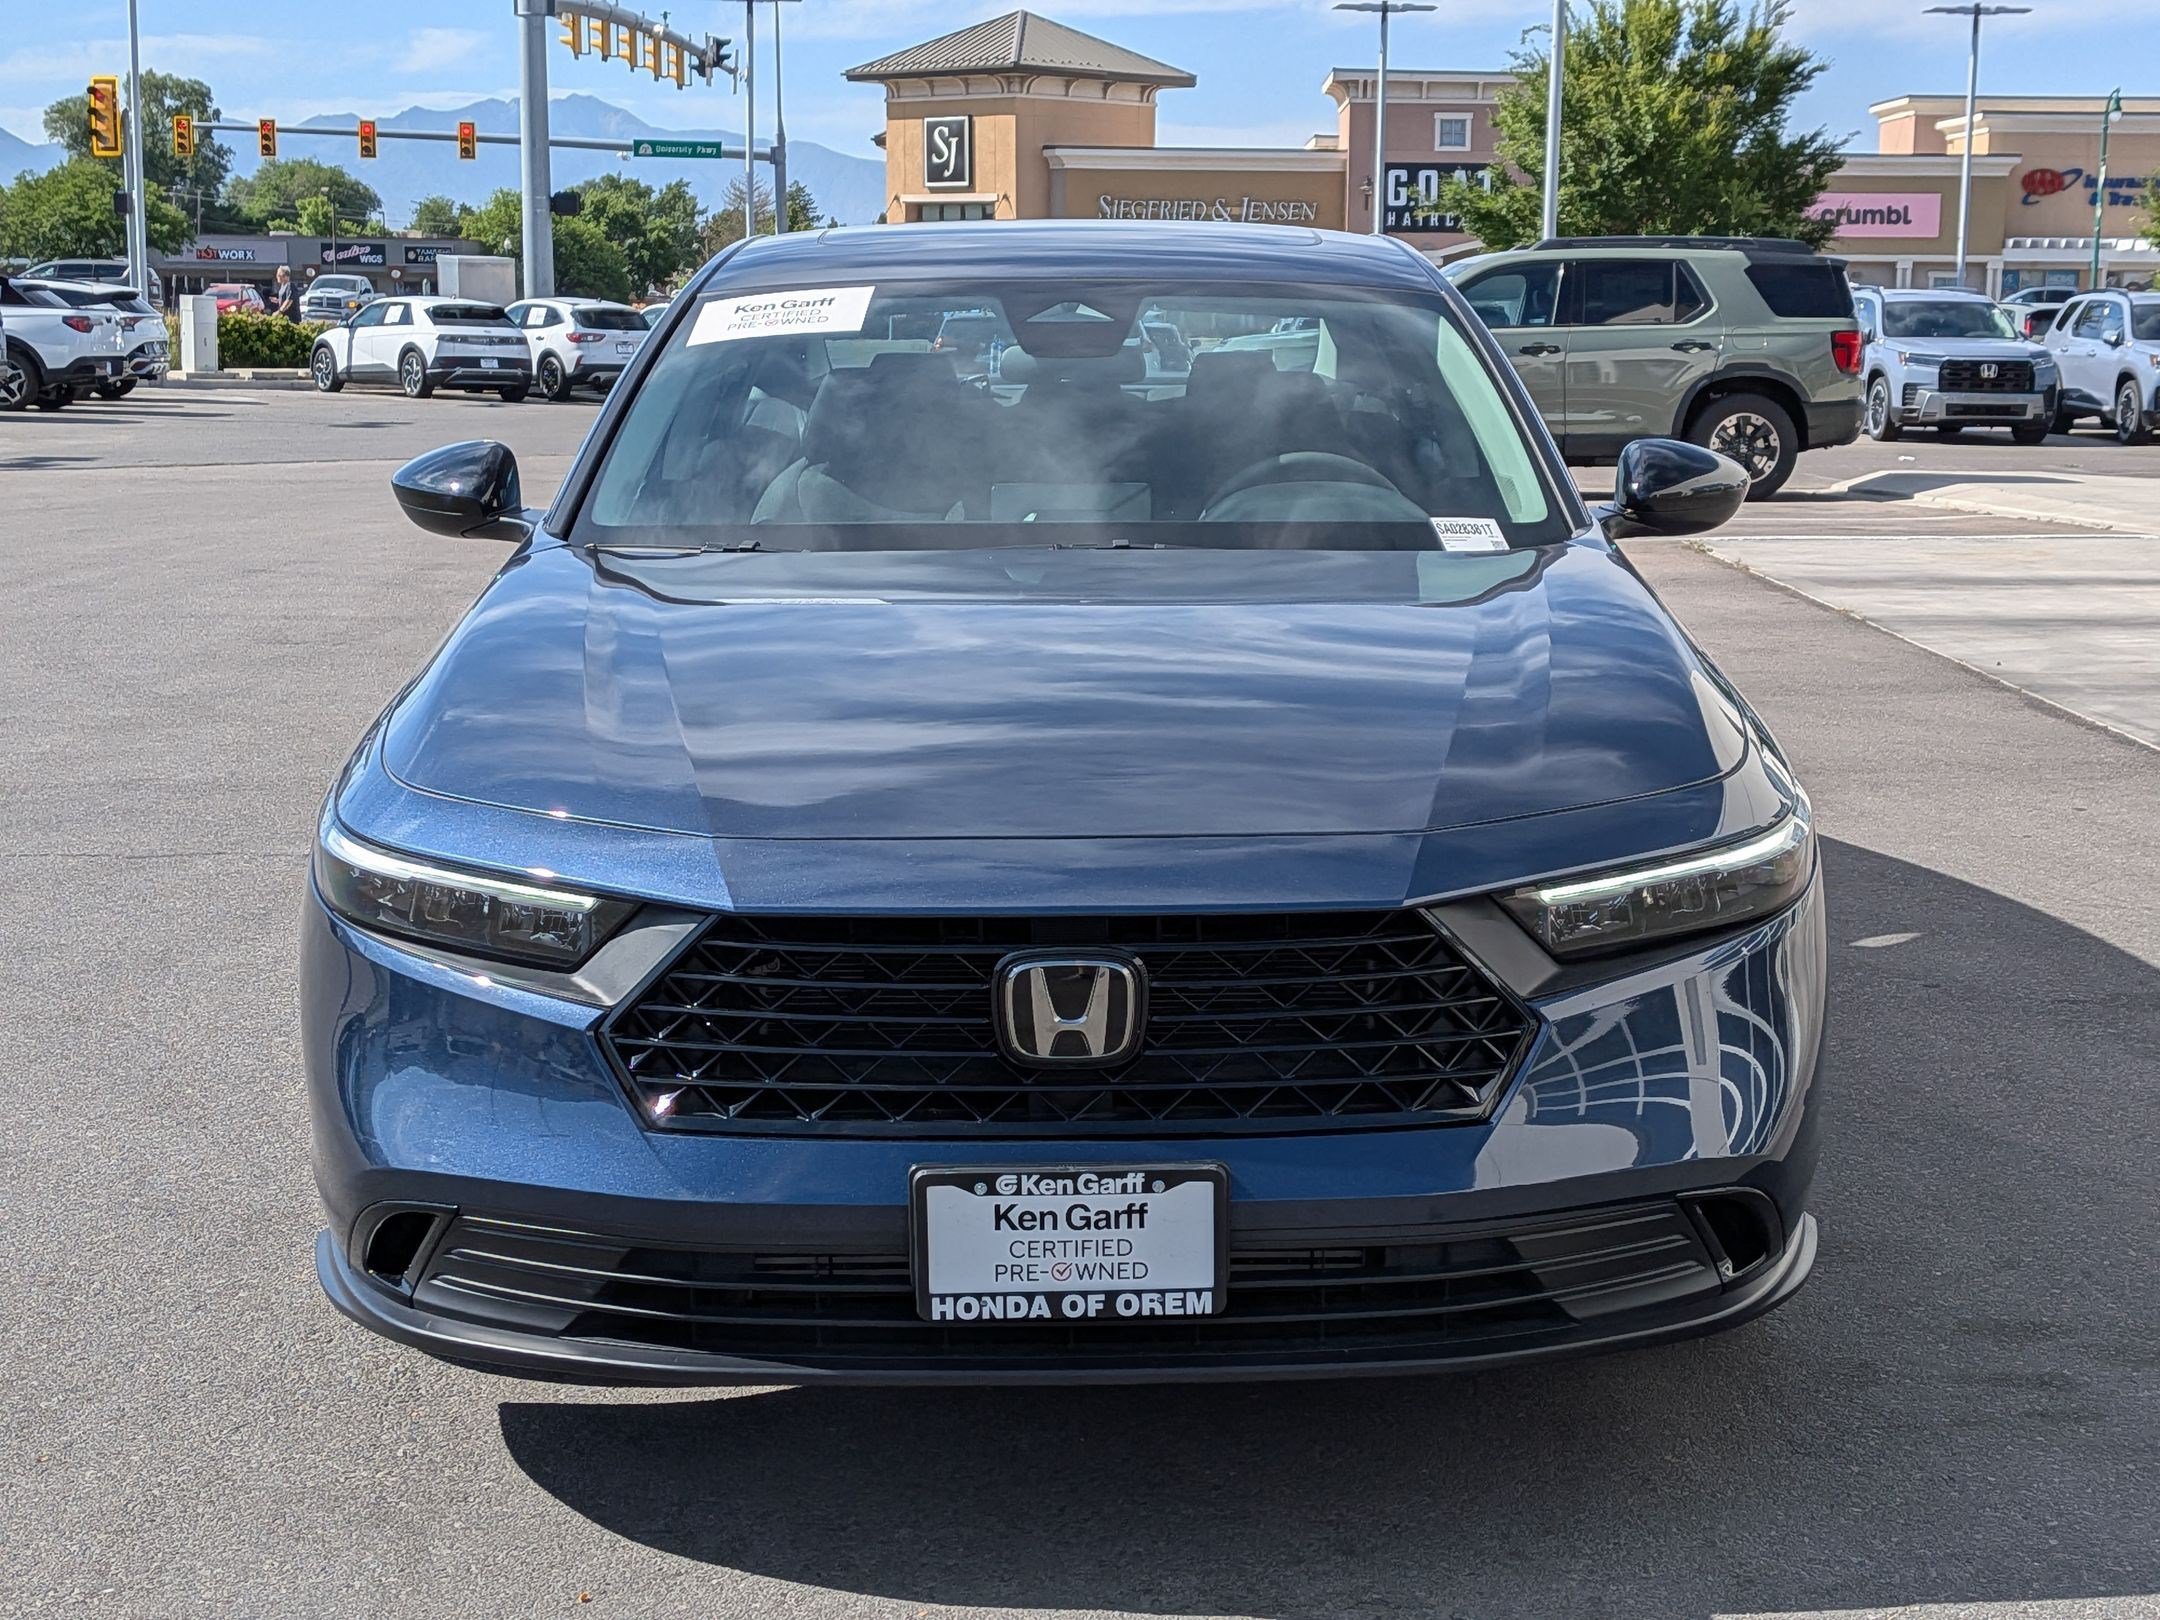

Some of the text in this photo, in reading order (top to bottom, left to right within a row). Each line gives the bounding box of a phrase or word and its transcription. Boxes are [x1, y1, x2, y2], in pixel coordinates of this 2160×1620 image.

[656, 145, 717, 156] University Pkwy
[932, 126, 959, 177] SJ
[1098, 195, 1318, 221] SIEGFRIED & JENSEN
[1820, 205, 1912, 225] crumbl
[360, 254, 383, 263] WIGS
[733, 297, 836, 315] Ken Garff
[741, 309, 821, 322] CERTIFIED
[1020, 1174, 1073, 1195] Ken
[1076, 1172, 1145, 1195] Garff
[993, 1202, 1149, 1231] Ken Garff
[1009, 1238, 1133, 1259] CERTIFIED
[931, 1291, 1213, 1321] HONDA OF OREM
